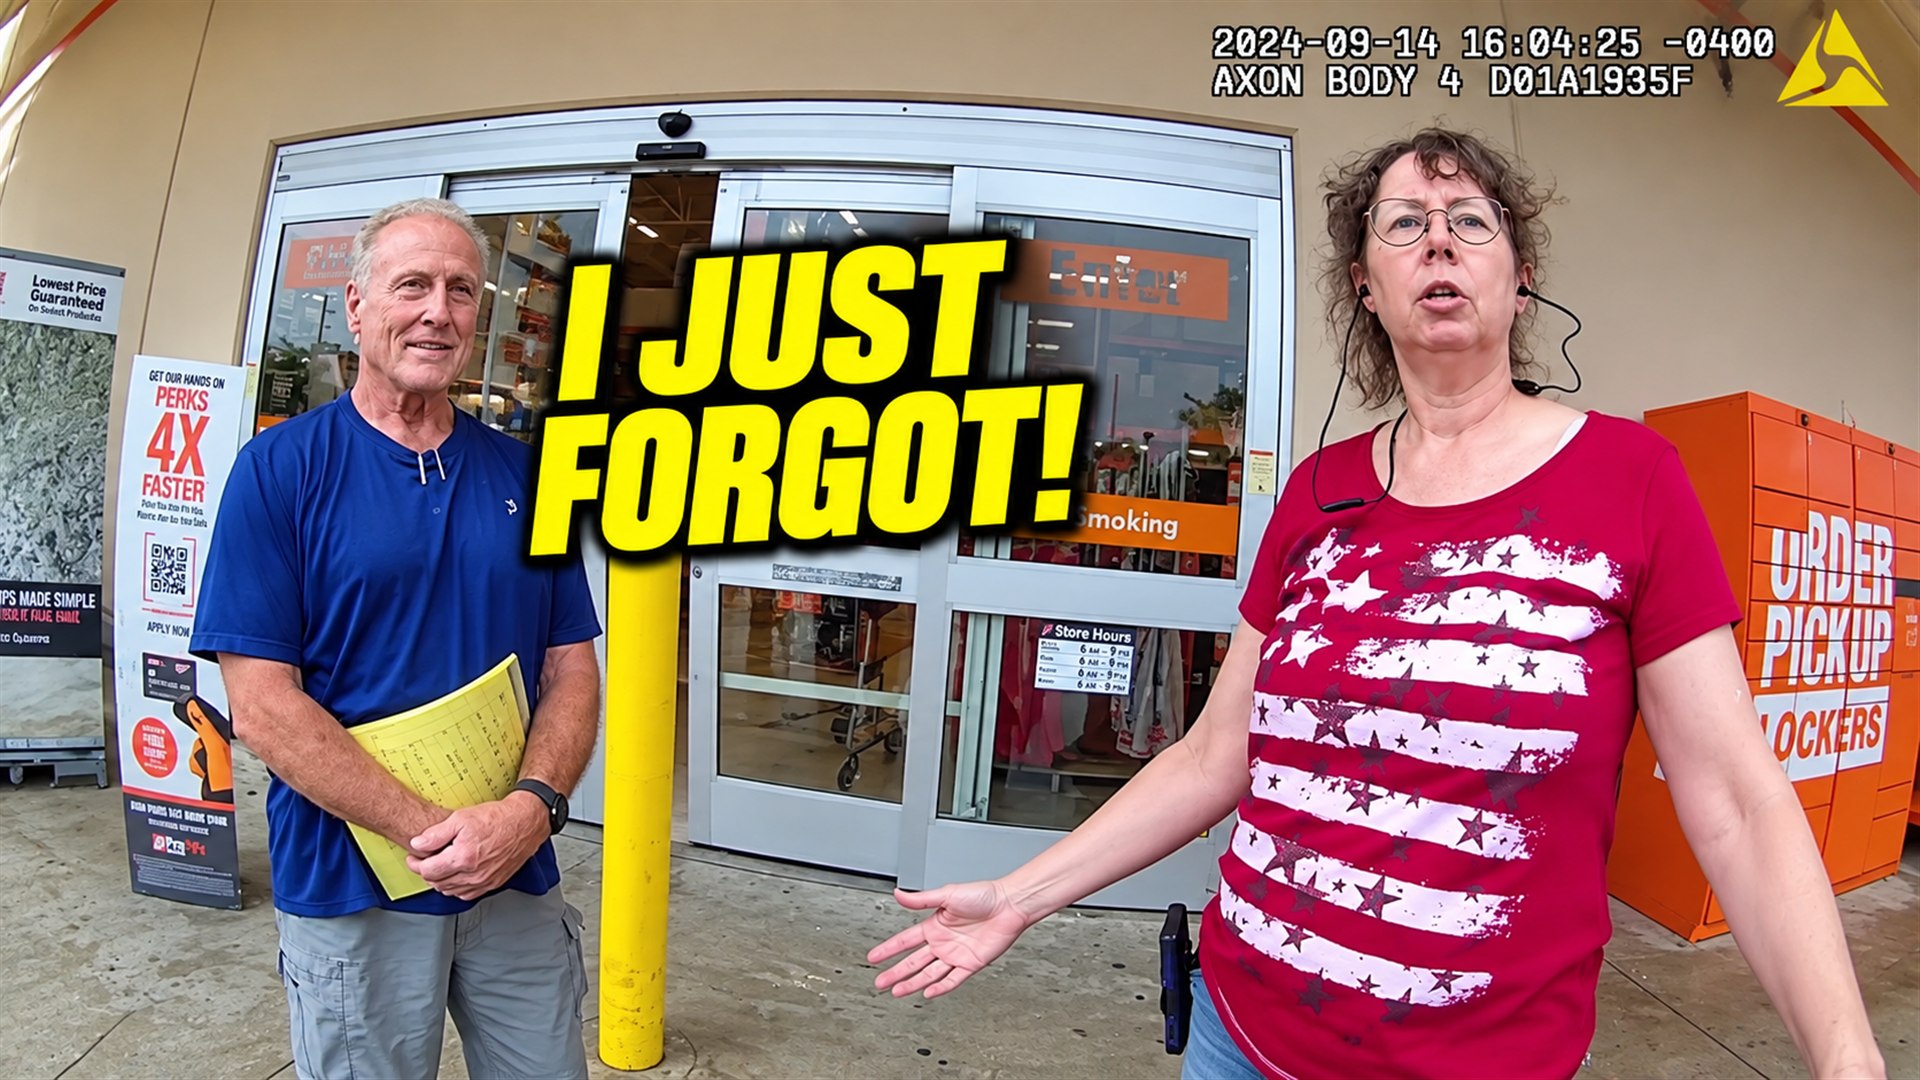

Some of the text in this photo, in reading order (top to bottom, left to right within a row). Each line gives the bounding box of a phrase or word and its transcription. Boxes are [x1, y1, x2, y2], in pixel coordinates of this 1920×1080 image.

[32, 274, 107, 298] Lowest Price
[30, 288, 104, 312] Guaranteed
[149, 369, 225, 389] GET OUR HANDS ON
[155, 385, 209, 412] PERKS
[146, 411, 211, 477] 4X
[142, 473, 205, 503] FASTER
[19, 590, 51, 607] MADE
[53, 591, 96, 609] SIMPLE
[147, 621, 171, 635] APPLY
[1055, 625, 1132, 643] Store Hours
[1080, 644, 1087, 654] 6
[1110, 646, 1117, 656] 9
[1760, 603, 1892, 688] PICKUP
[1077, 680, 1084, 689] 6
[1104, 682, 1112, 691] 9
[1760, 704, 1882, 762] OCKERS
